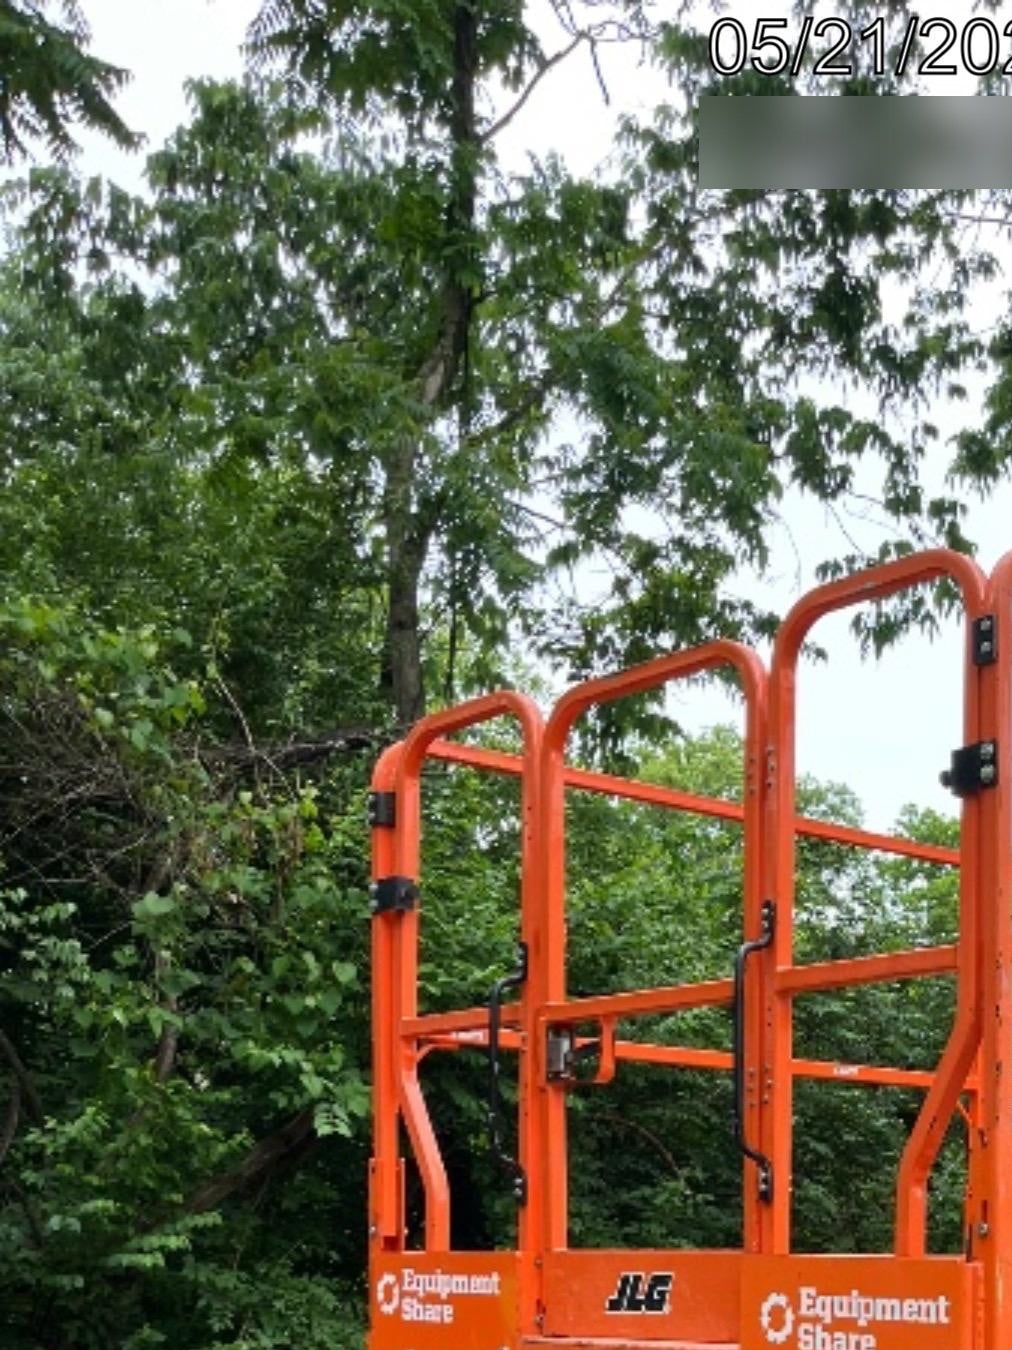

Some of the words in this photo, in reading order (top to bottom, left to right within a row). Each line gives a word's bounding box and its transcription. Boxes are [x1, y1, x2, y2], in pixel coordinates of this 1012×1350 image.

[401, 1268, 501, 1300] Equipment
[605, 1271, 675, 1315] JLG
[401, 1297, 453, 1324] Share
[799, 1286, 950, 1327] Equipment
